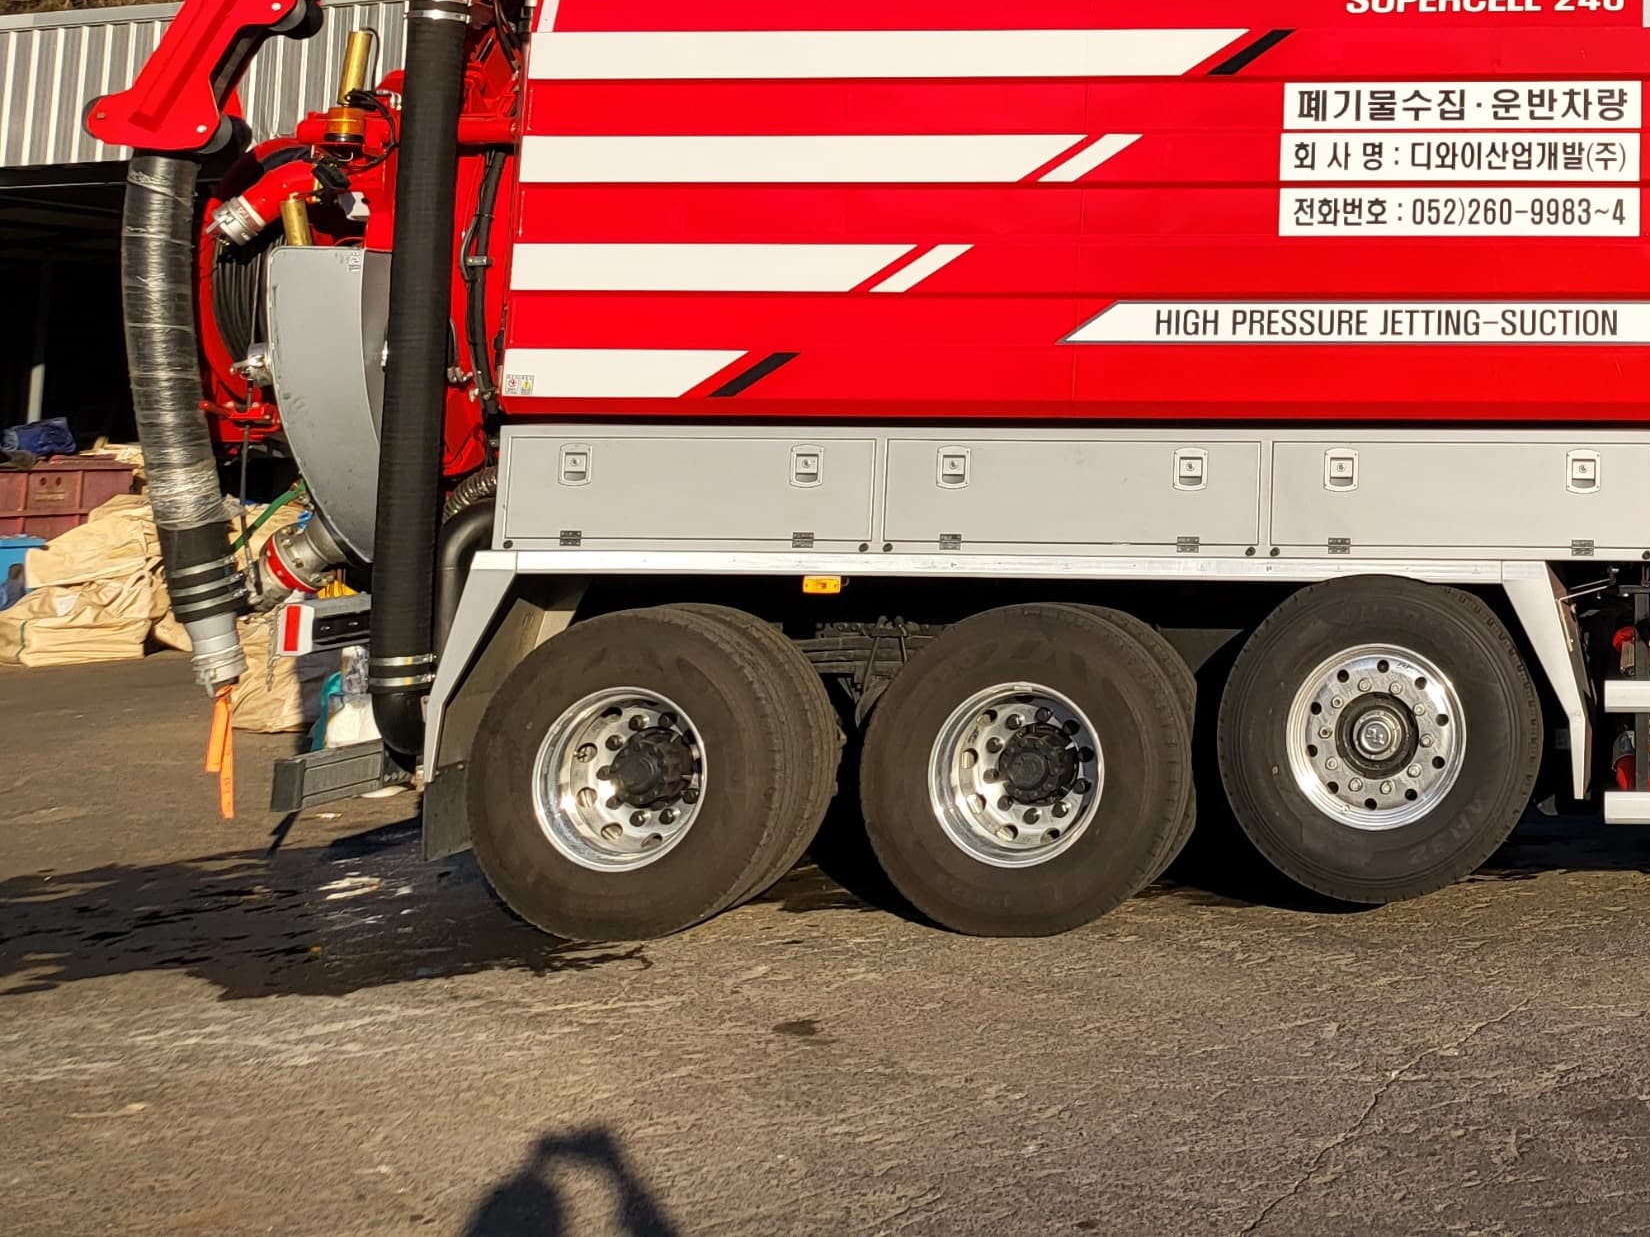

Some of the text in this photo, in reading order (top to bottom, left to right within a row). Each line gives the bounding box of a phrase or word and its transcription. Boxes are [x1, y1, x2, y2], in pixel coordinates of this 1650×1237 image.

[1411, 141, 1627, 173] 디와이산업개발(주)
[1293, 197, 1388, 227] 전화번호
[1412, 198, 1626, 226] 052)260-9983~4
[1155, 309, 1618, 337] HIGH PRESSURE JETTING-SUCTION
